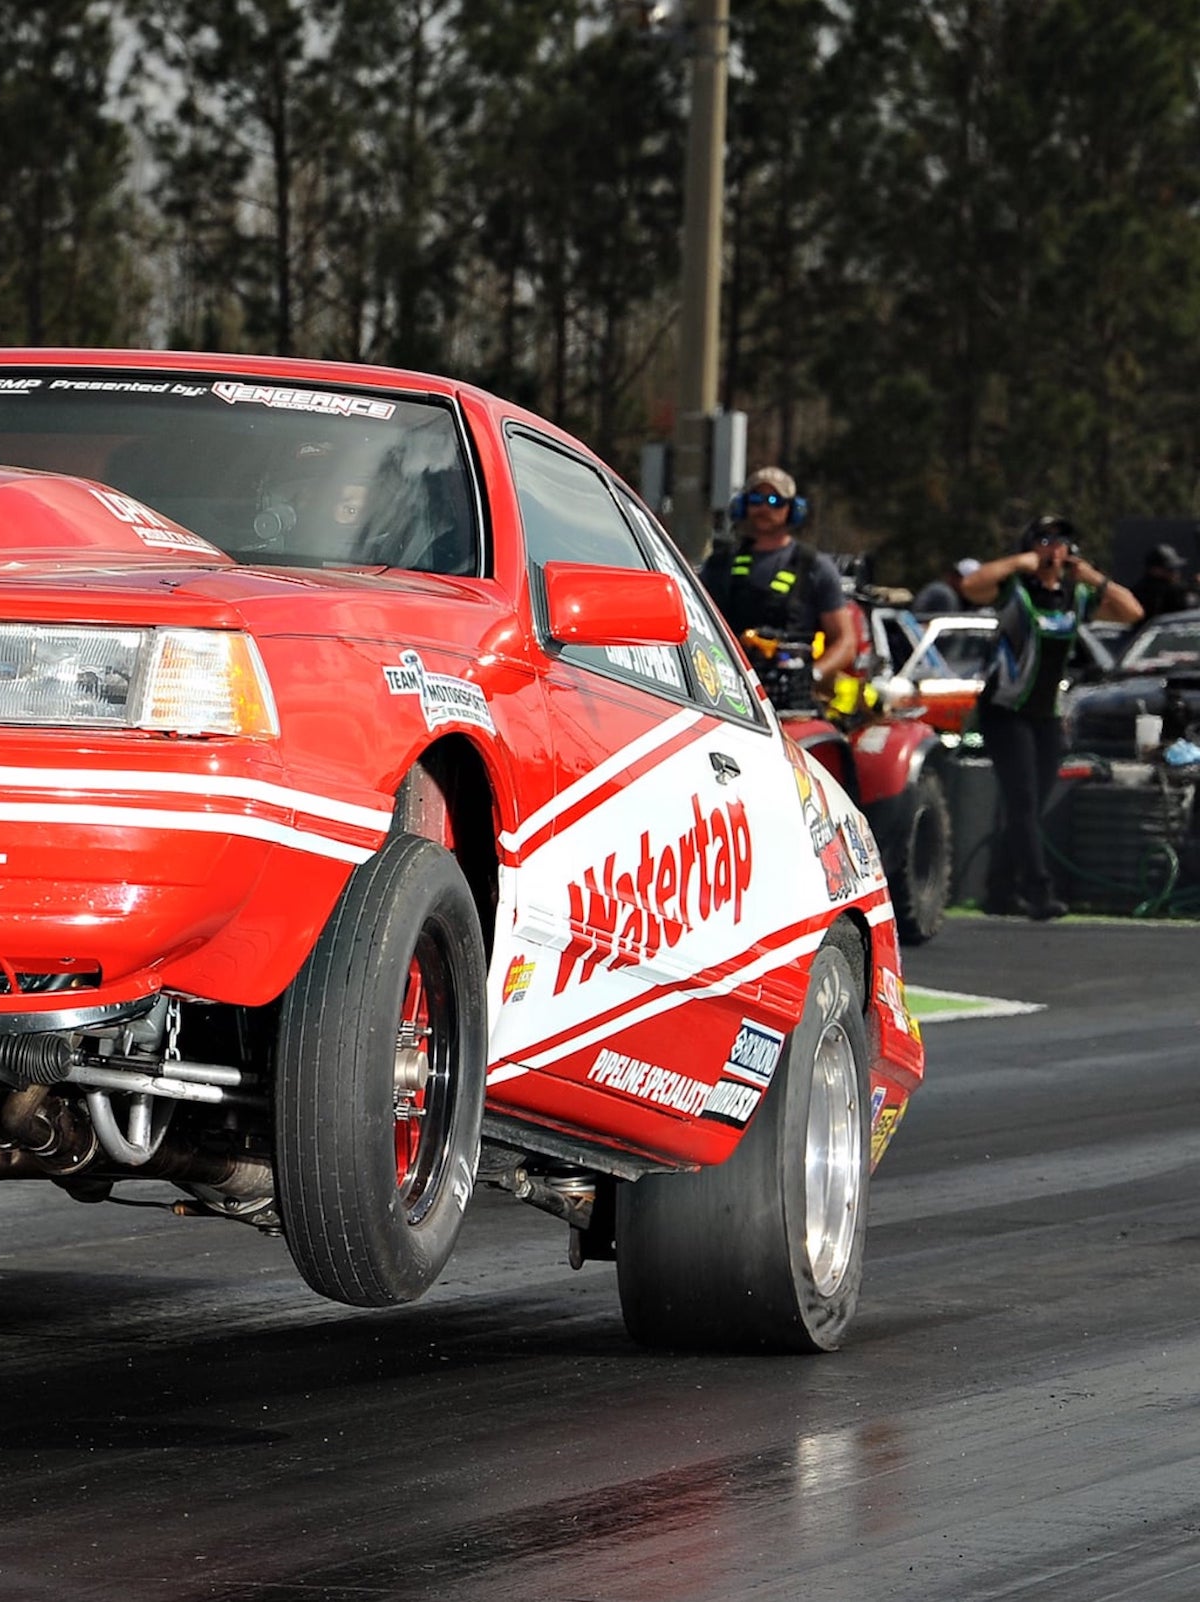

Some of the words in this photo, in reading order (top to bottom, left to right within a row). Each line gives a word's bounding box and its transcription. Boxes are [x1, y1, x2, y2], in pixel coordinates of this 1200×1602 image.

[50, 379, 169, 393] Presented
[171, 384, 207, 397] by:
[215, 382, 392, 417] VENGEANCE
[386, 671, 420, 690] TEAM
[553, 793, 752, 996] Watertap
[587, 1048, 650, 1098] PIPELINE
[638, 1066, 716, 1118] SPECIALISTS
